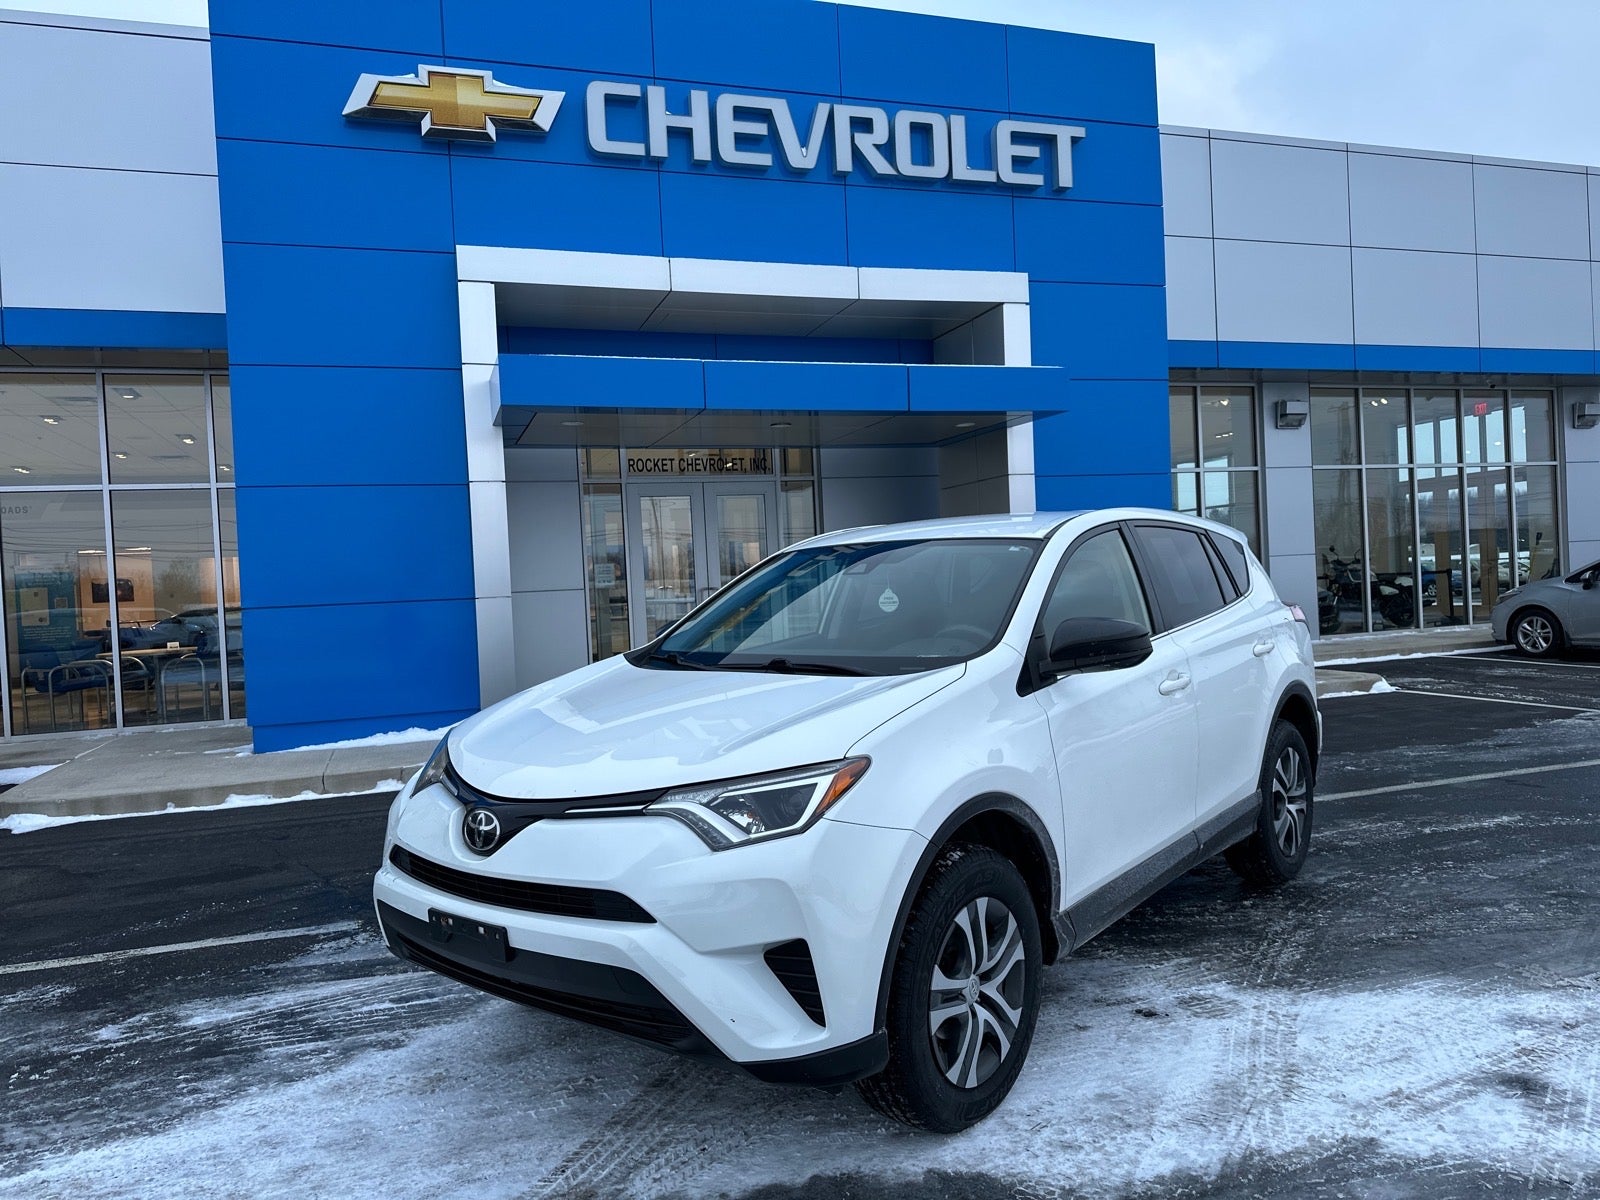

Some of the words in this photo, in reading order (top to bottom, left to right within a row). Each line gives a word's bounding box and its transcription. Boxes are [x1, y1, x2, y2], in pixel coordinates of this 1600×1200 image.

[585, 80, 1086, 190] CHEVROLET
[627, 458, 675, 472] ROCKET
[679, 458, 747, 473] CHEVROLET,
[749, 457, 771, 471] INC.
